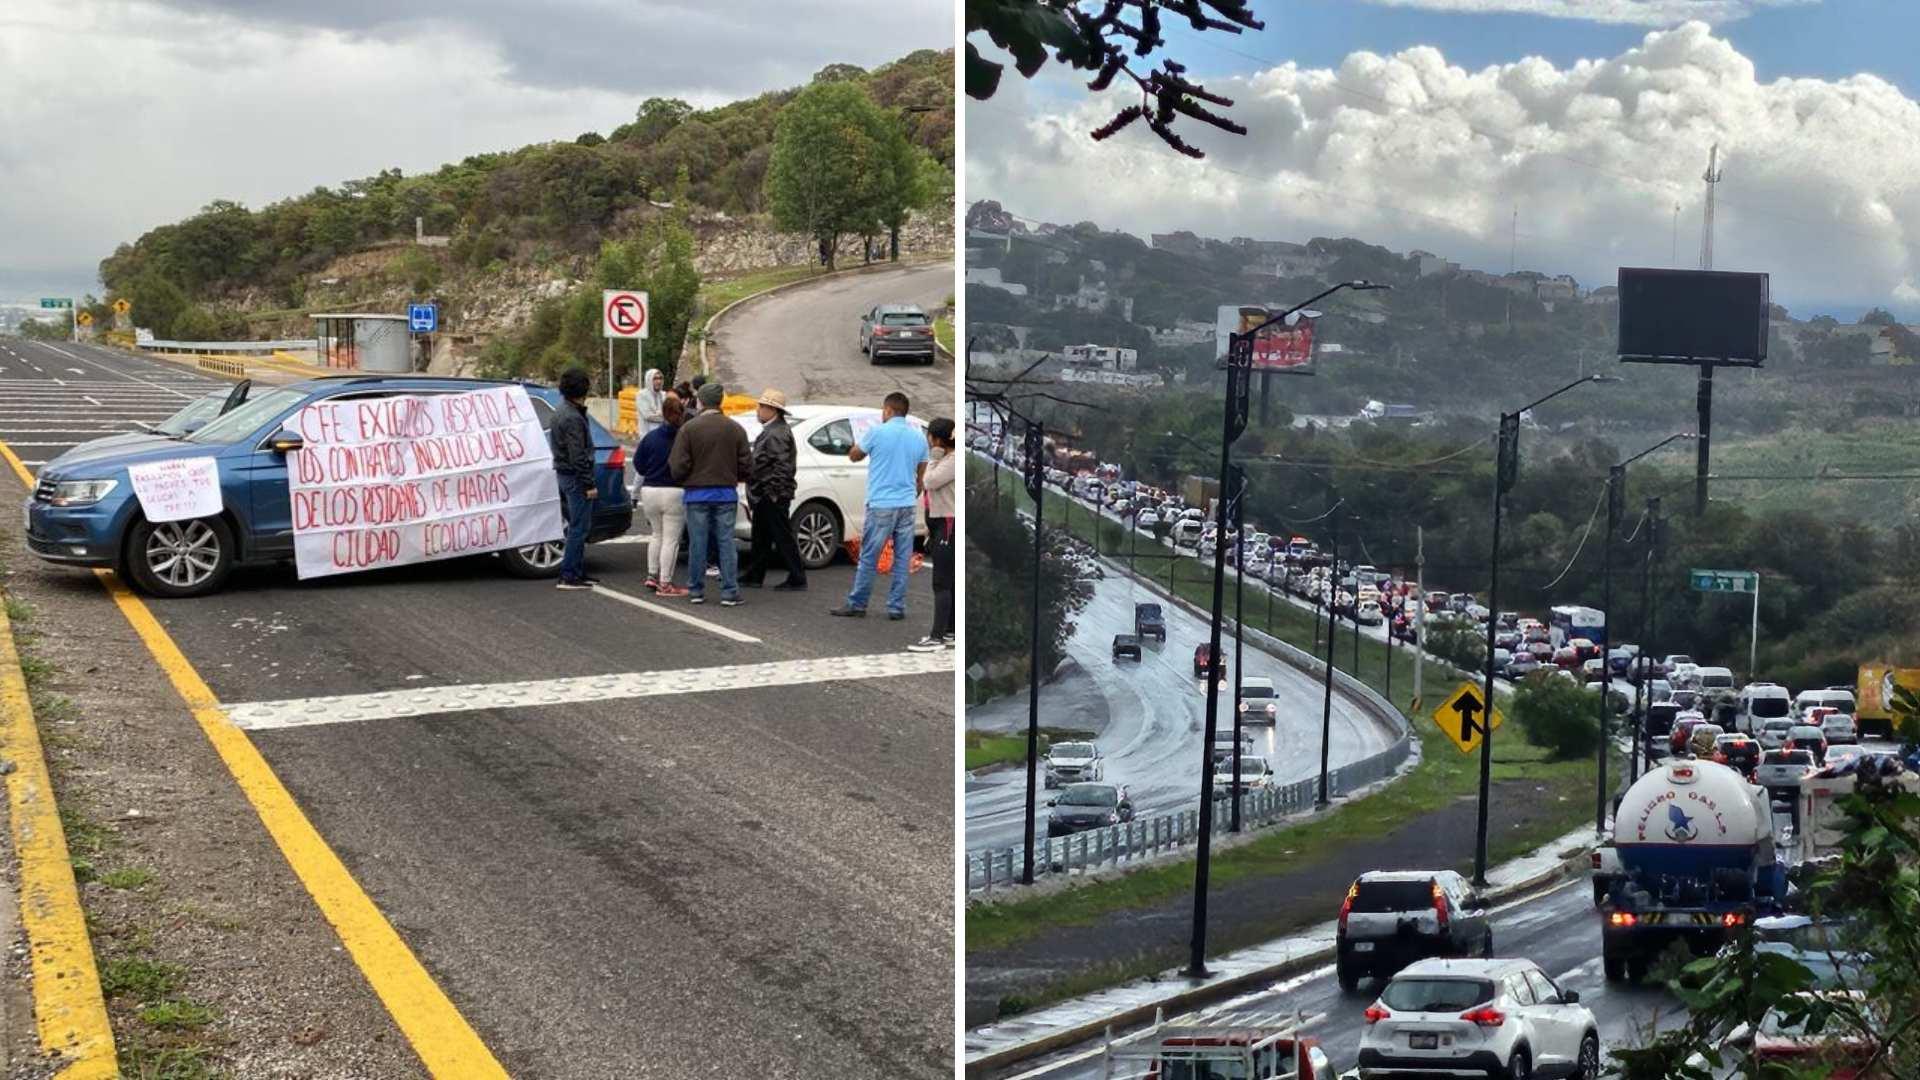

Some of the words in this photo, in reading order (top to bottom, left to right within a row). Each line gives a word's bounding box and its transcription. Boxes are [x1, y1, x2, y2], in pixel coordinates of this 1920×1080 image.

[300, 404, 343, 443] CFE
[506, 391, 521, 423] A
[297, 446, 324, 484] LOS
[329, 441, 405, 482] CONTRATOS
[432, 479, 453, 512] DE
[457, 473, 511, 510] HARAS
[333, 529, 401, 567] CIUDAD
[1638, 791, 1676, 841] PELIGRO
